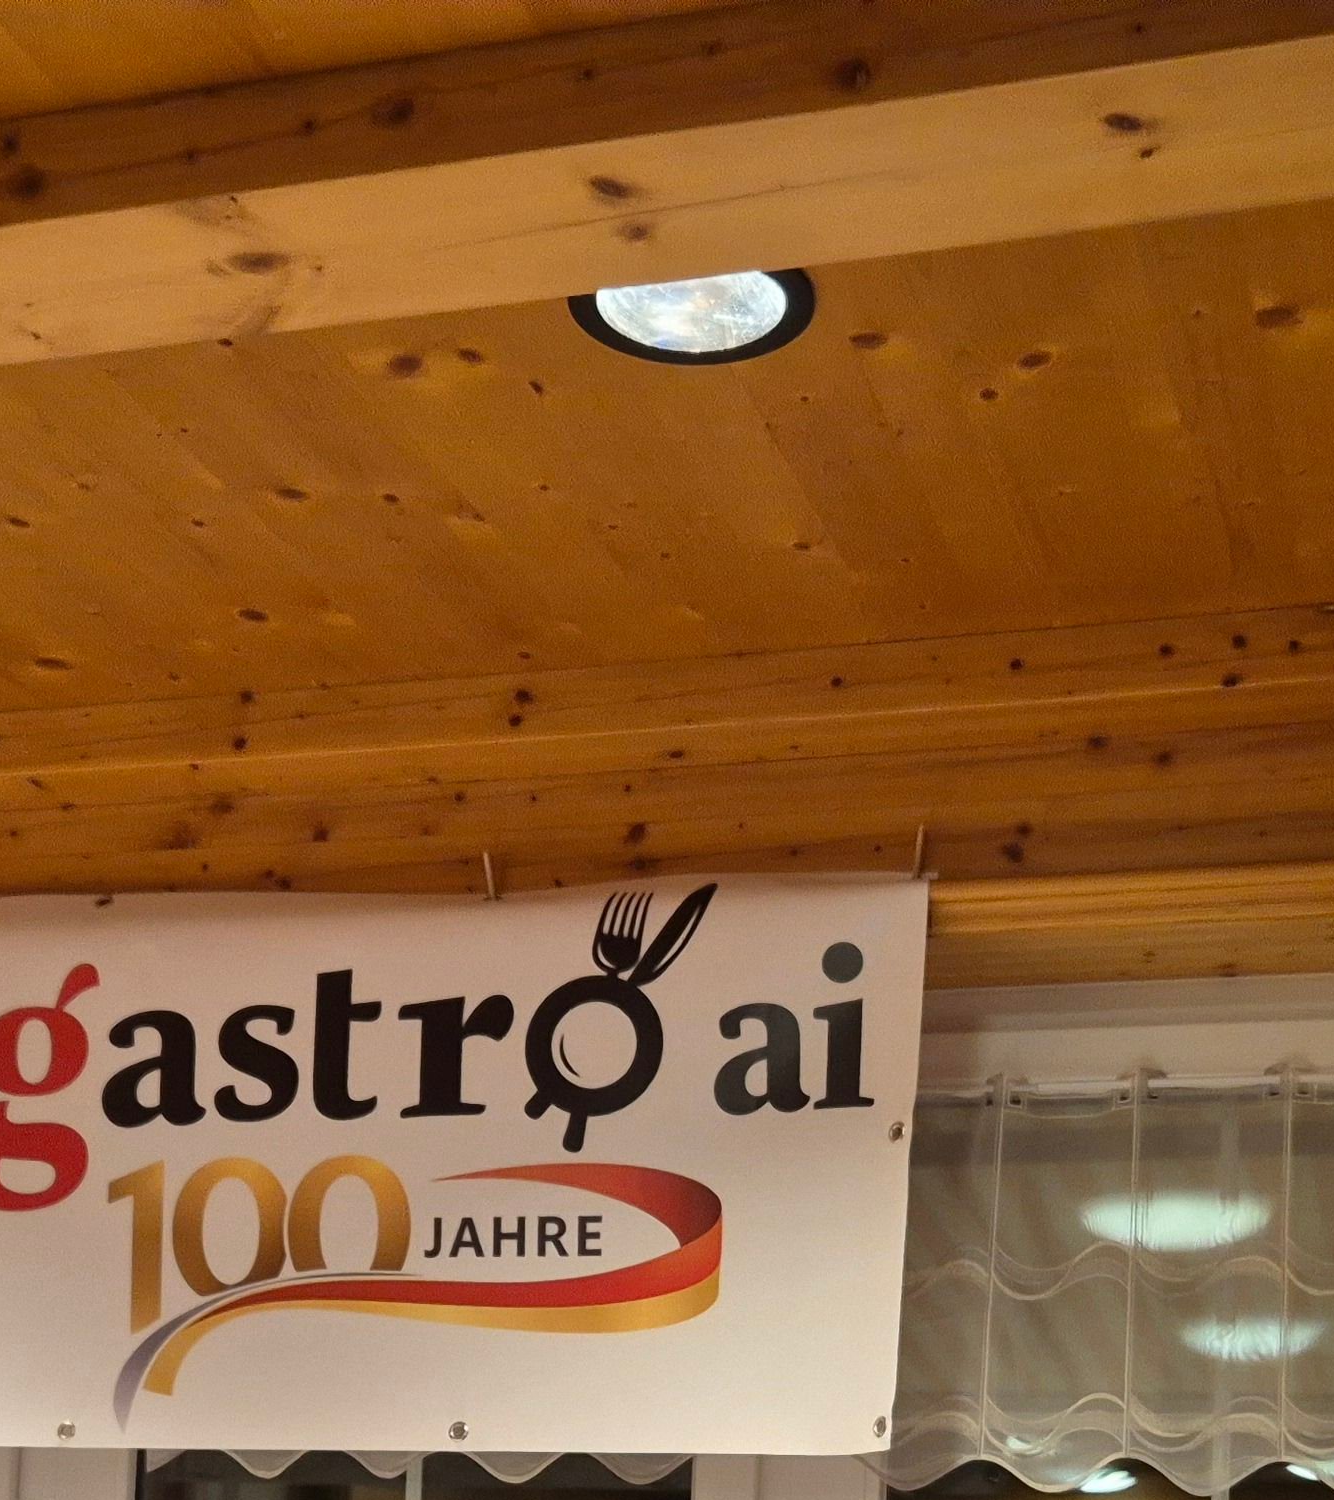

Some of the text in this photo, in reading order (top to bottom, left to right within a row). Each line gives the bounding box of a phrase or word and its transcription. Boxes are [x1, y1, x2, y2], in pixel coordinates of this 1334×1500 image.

[713, 941, 875, 1116] ai
[107, 1155, 603, 1334] 100 JAHRE
